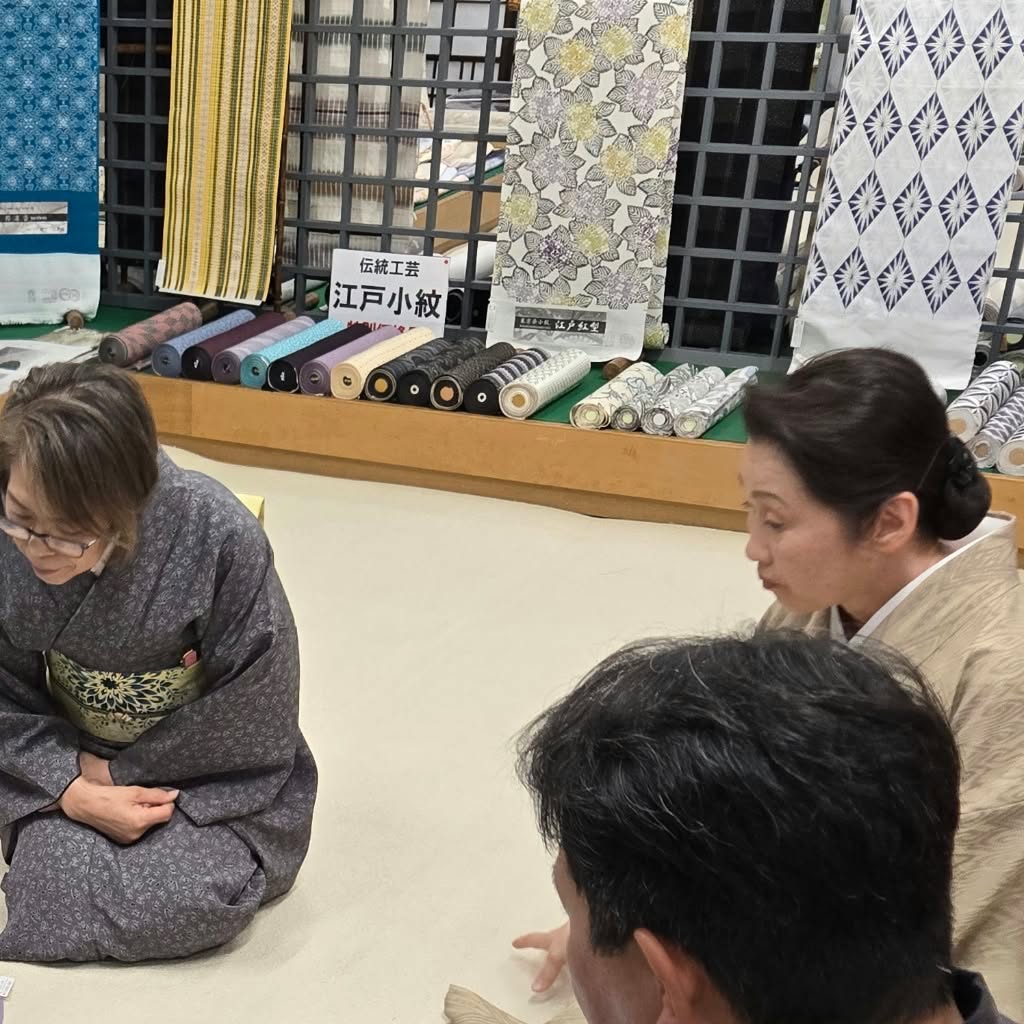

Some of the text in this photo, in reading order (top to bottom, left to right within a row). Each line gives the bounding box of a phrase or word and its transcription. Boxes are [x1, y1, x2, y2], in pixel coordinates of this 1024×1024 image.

[360, 257, 420, 277] 伝統工芸
[333, 282, 442, 319] 江戸小紋
